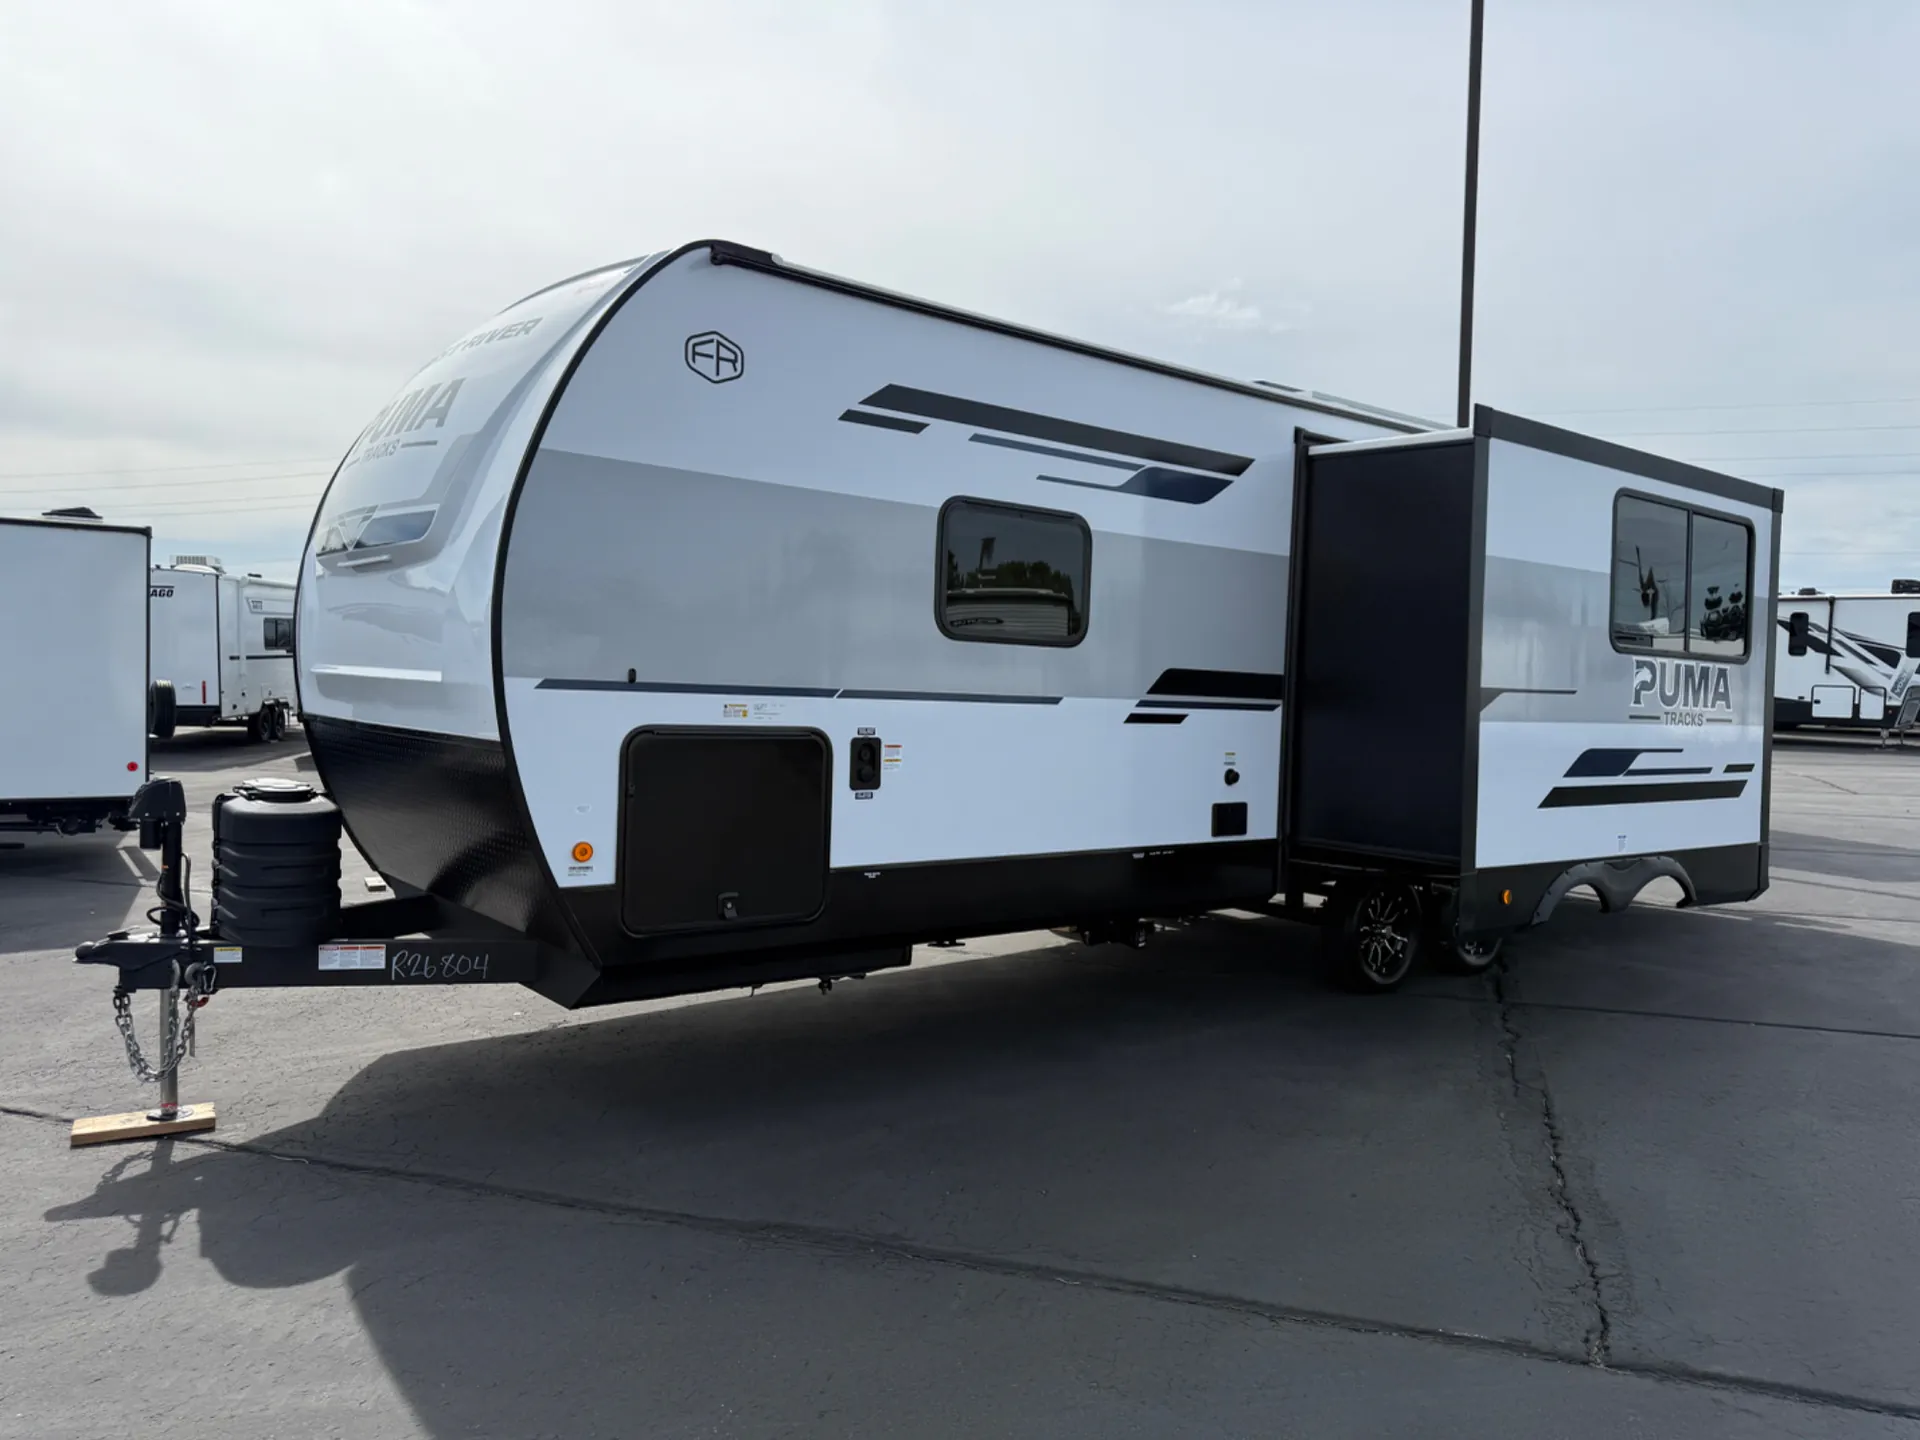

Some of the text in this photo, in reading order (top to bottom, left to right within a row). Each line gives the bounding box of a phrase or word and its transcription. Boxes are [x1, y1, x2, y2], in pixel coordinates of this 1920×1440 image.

[461, 317, 543, 351] RIVER
[1631, 657, 1733, 711] PUMA
[1664, 711, 1704, 727] TRACKS
